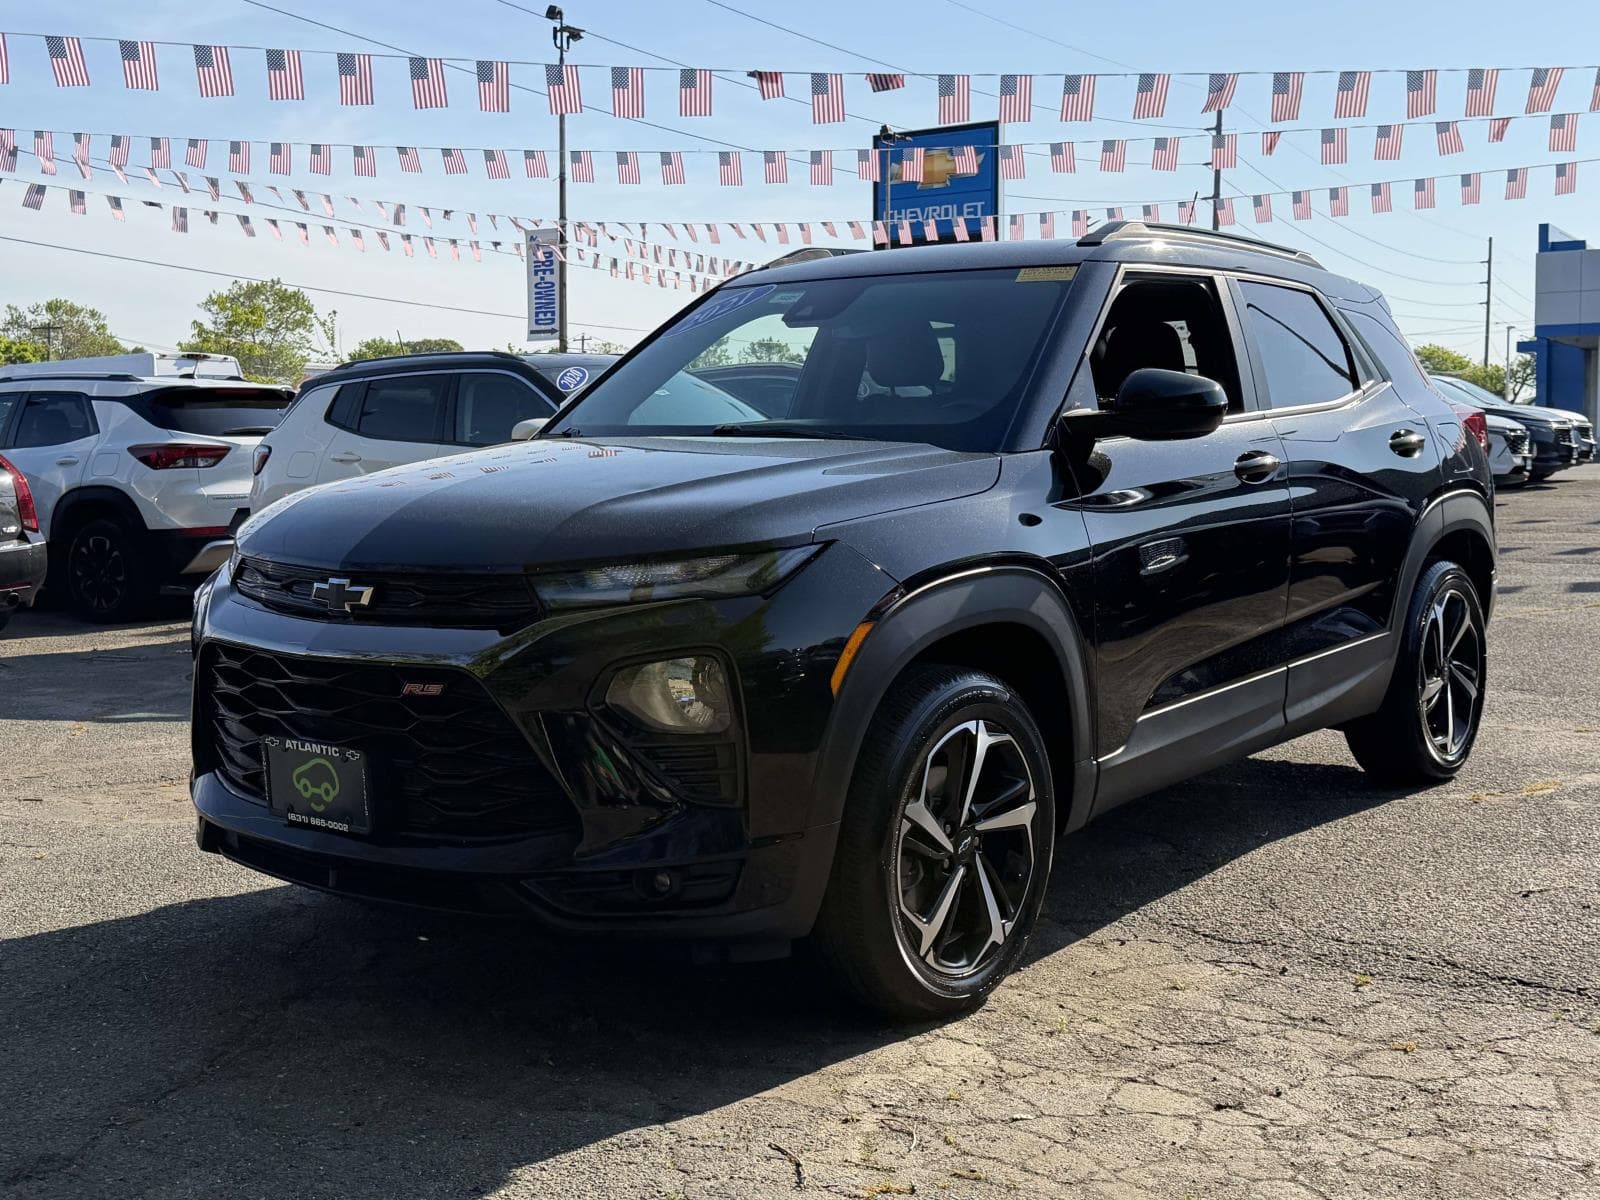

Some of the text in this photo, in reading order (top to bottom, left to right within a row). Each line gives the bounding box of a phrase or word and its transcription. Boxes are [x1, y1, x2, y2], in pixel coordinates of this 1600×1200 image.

[884, 202, 985, 225] CHEVROLET
[533, 251, 556, 326] PRE-OWNED
[561, 369, 583, 389] 2020
[403, 683, 444, 696] RS
[285, 739, 340, 757] ATLANTIC
